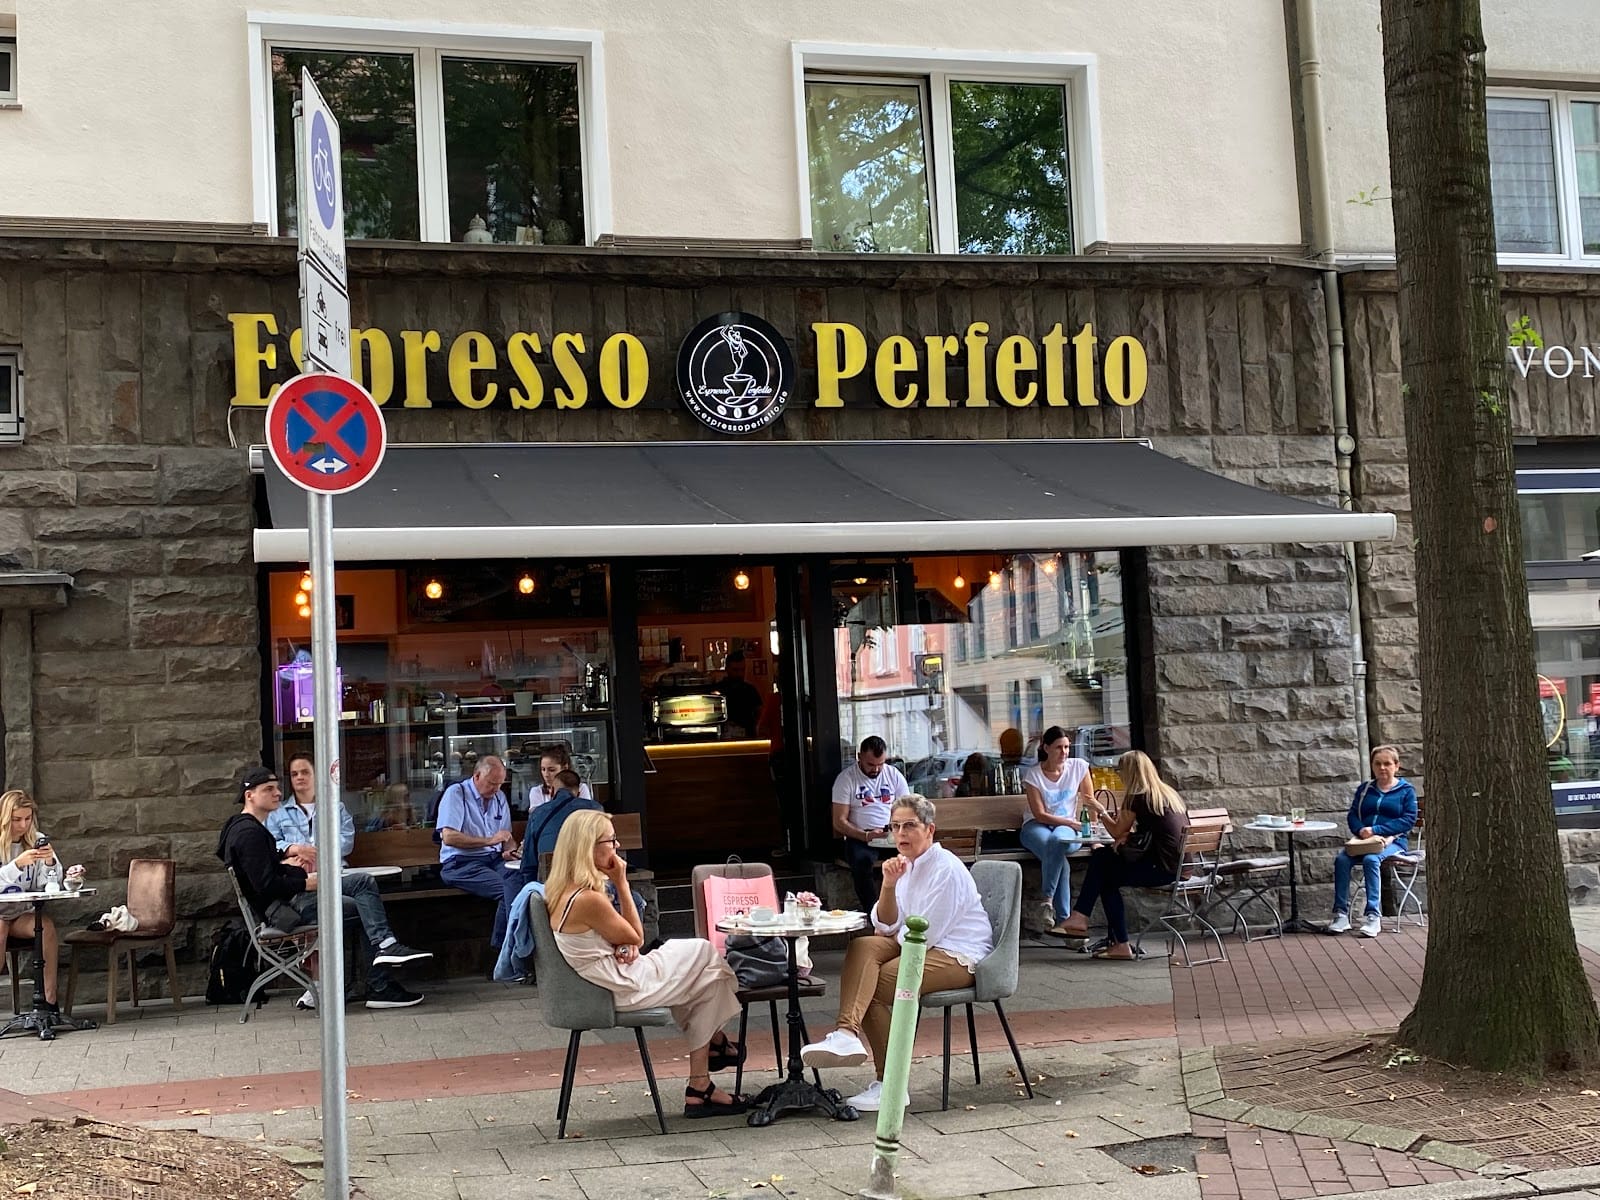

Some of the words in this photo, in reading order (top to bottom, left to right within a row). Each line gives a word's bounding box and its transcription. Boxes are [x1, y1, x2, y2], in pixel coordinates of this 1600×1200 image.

[335, 320, 347, 348] frei
[812, 322, 1148, 408] Perfetto
[723, 895, 760, 906] ESPRESSO
